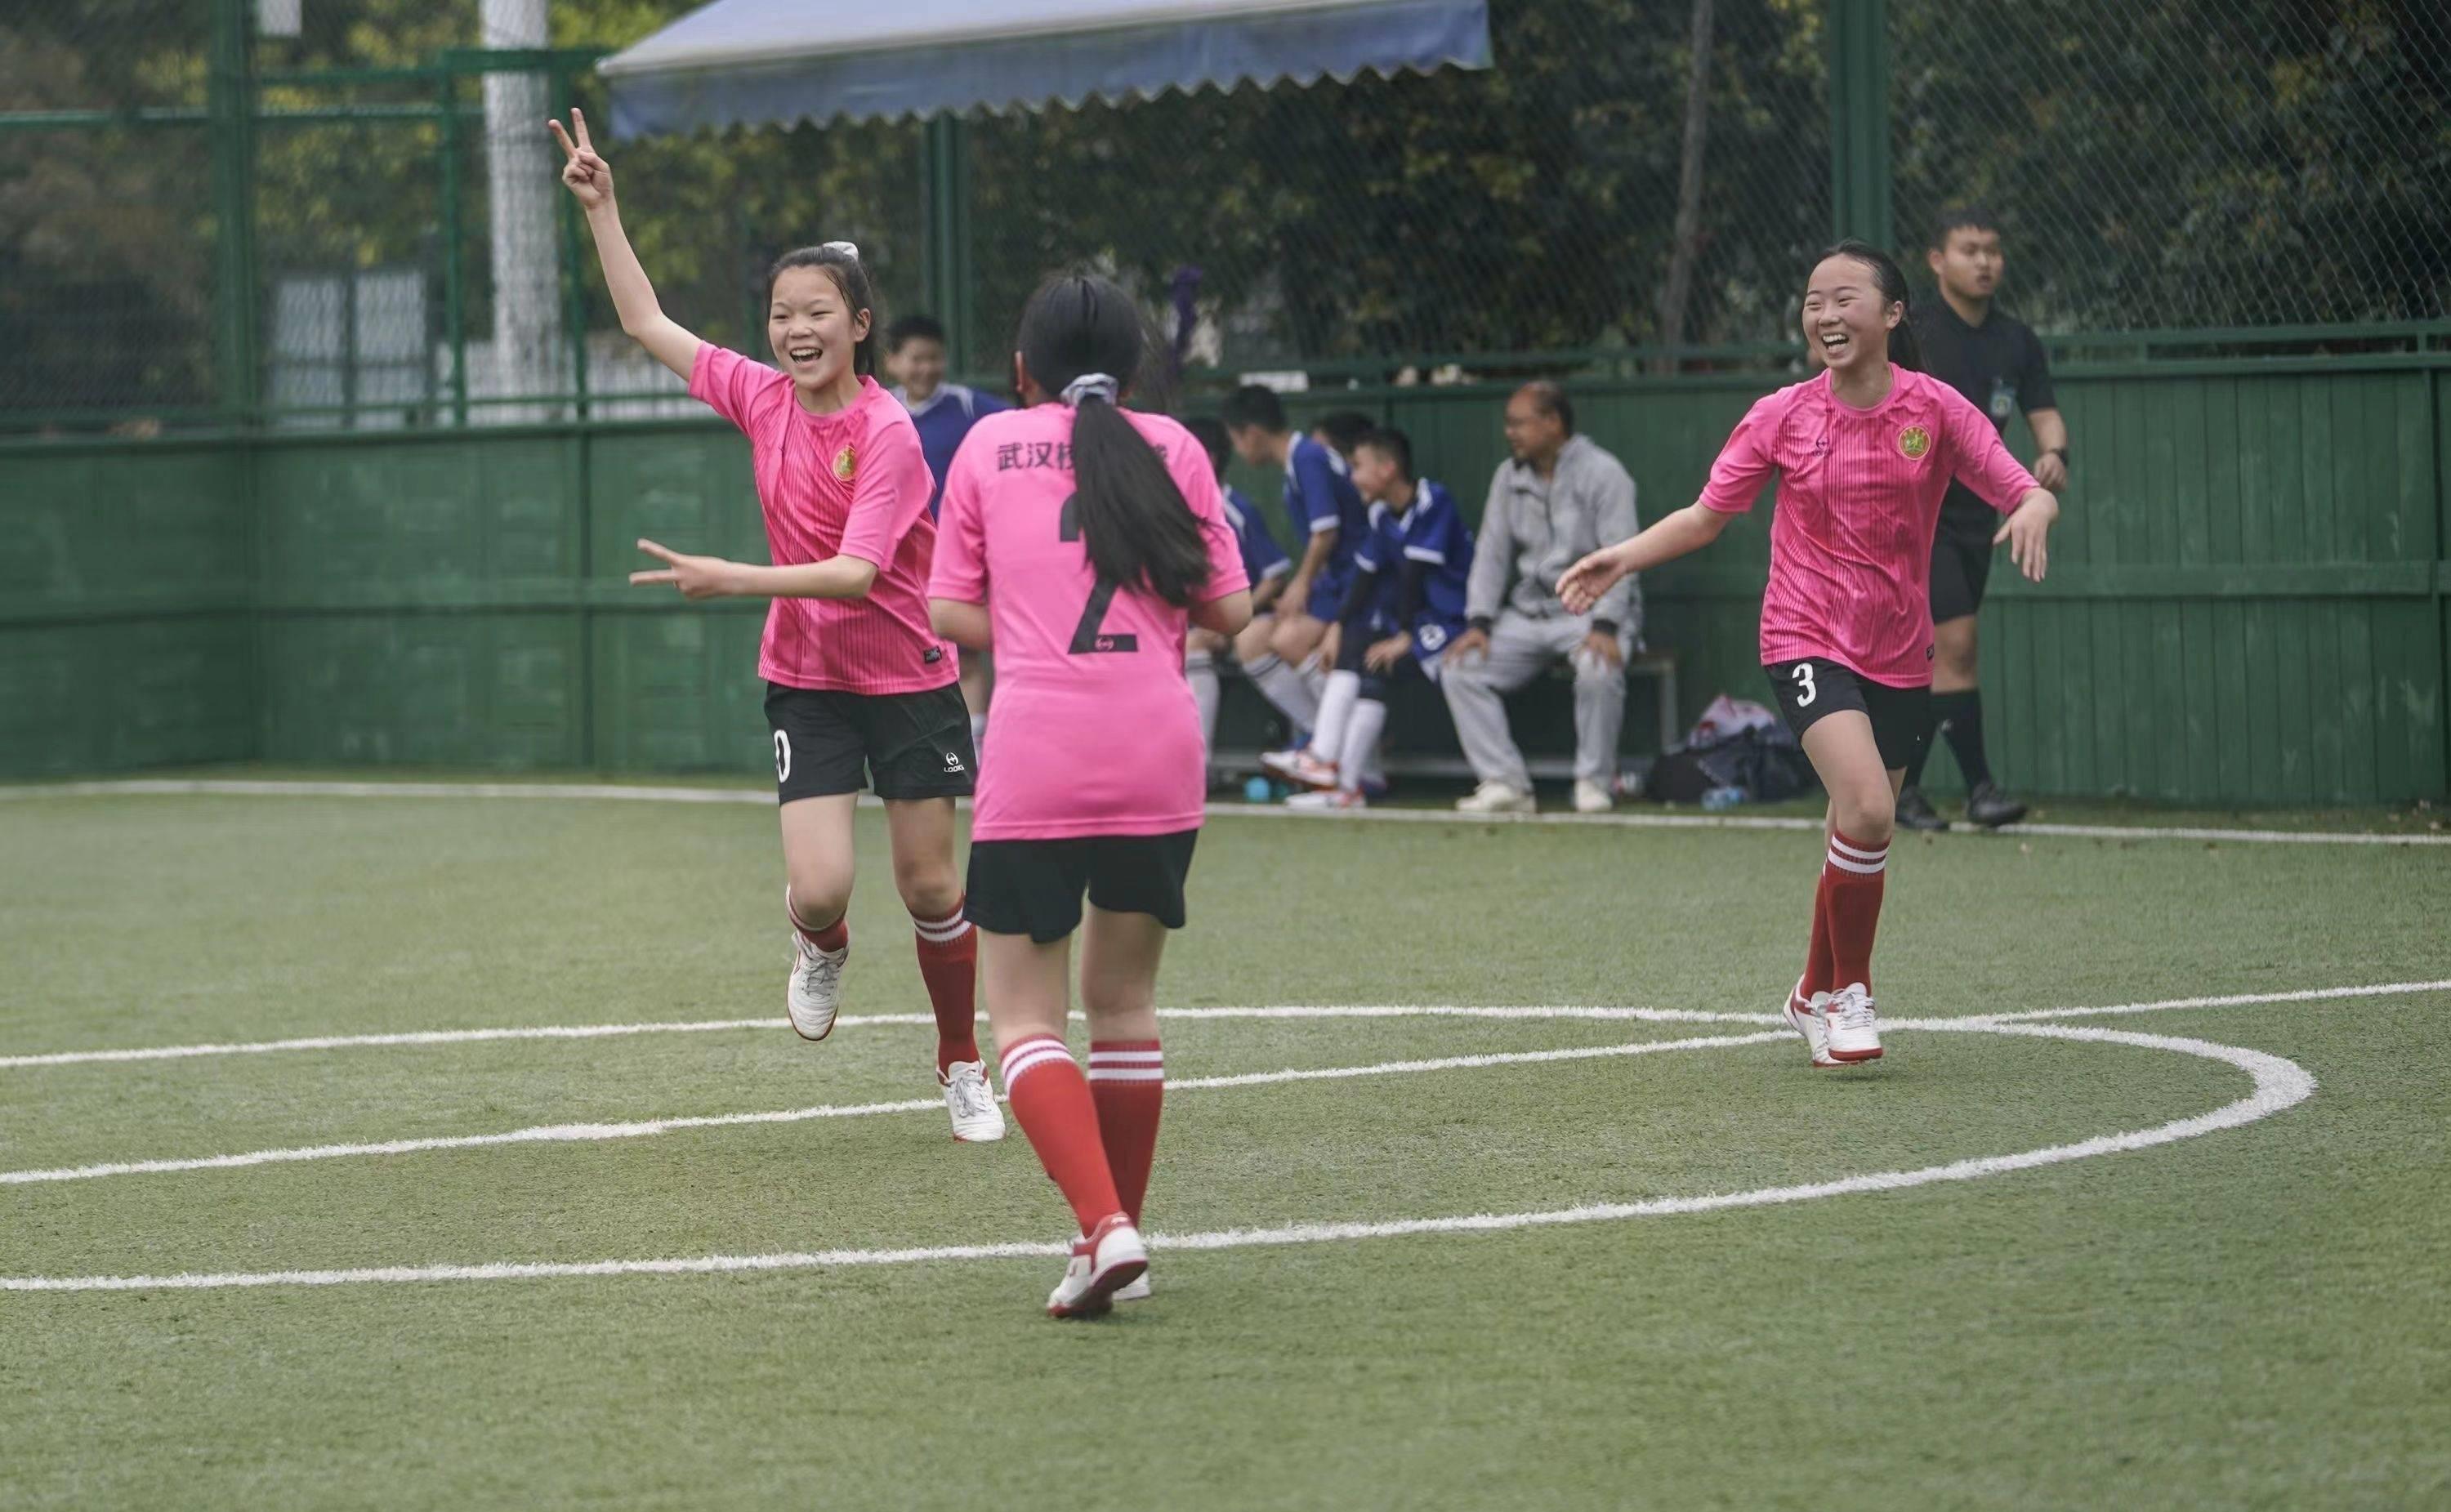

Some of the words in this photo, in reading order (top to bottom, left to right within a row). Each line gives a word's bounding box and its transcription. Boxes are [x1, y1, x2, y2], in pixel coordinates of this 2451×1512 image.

[1060, 488, 1139, 654] 2
[1792, 662, 1816, 707] 3
[774, 729, 792, 783] 0
